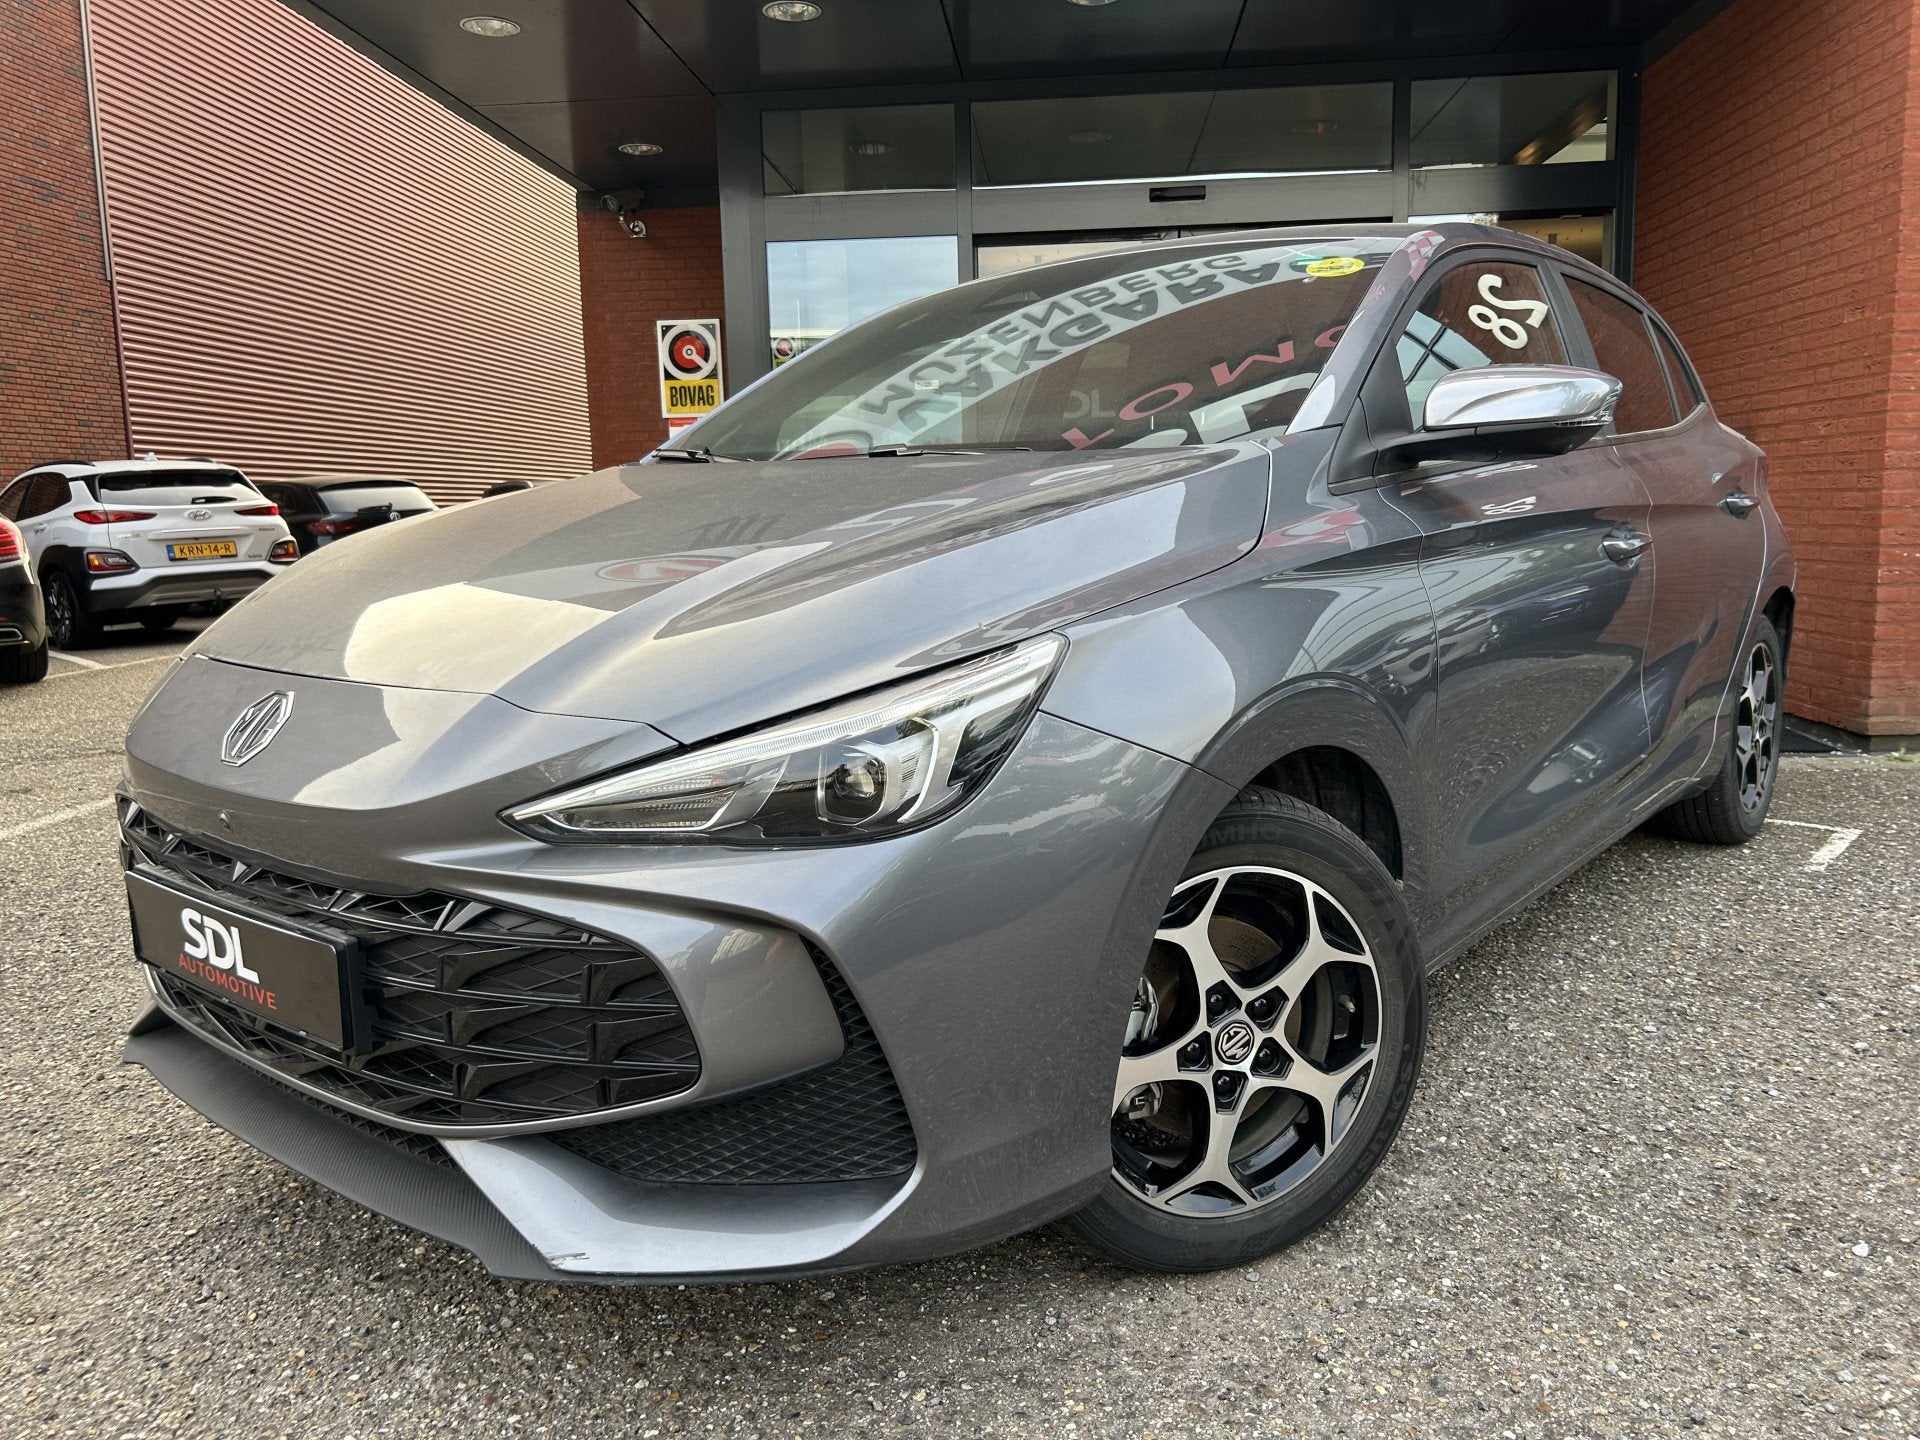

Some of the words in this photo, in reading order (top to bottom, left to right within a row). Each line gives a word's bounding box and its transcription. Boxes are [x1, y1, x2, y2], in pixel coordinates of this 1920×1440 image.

[669, 385, 715, 407] BOVAG
[179, 543, 232, 556] KRN-14-R
[223, 692, 291, 763] MG
[181, 907, 260, 984] SDL
[178, 953, 278, 1011] AUTOMOTIVE
